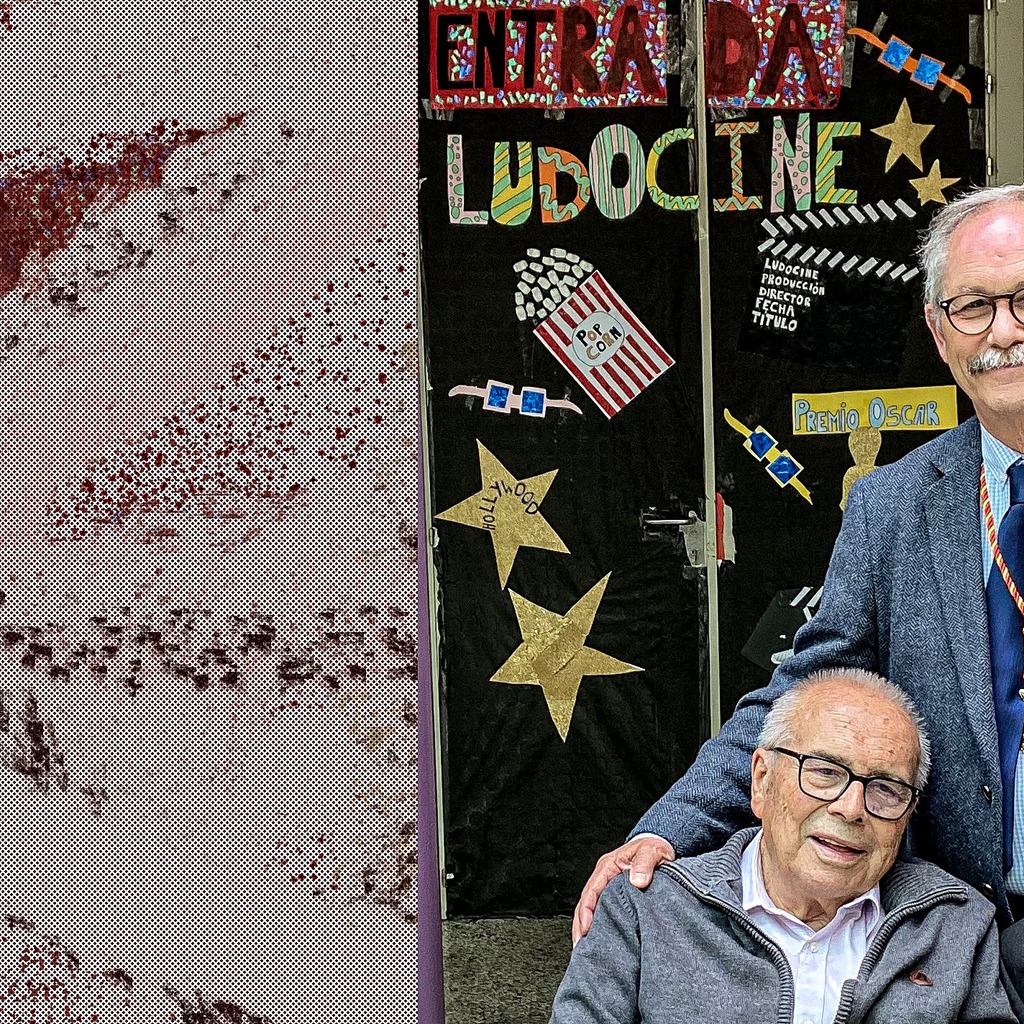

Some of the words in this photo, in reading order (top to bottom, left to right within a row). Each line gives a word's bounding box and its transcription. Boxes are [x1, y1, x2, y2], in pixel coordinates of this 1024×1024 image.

[436, 4, 830, 98] ENTRADA
[447, 113, 862, 226] LUDOCINE
[764, 257, 819, 280] LUDOCINE
[758, 286, 811, 307] DIRECTOR
[761, 273, 825, 296] PRODUCCIÓN
[755, 296, 795, 317] FECHA
[576, 323, 602, 347] POP
[586, 325, 622, 360] CORN
[869, 397, 940, 428] OSCAR
[479, 480, 539, 530] HOLLYWOOD
